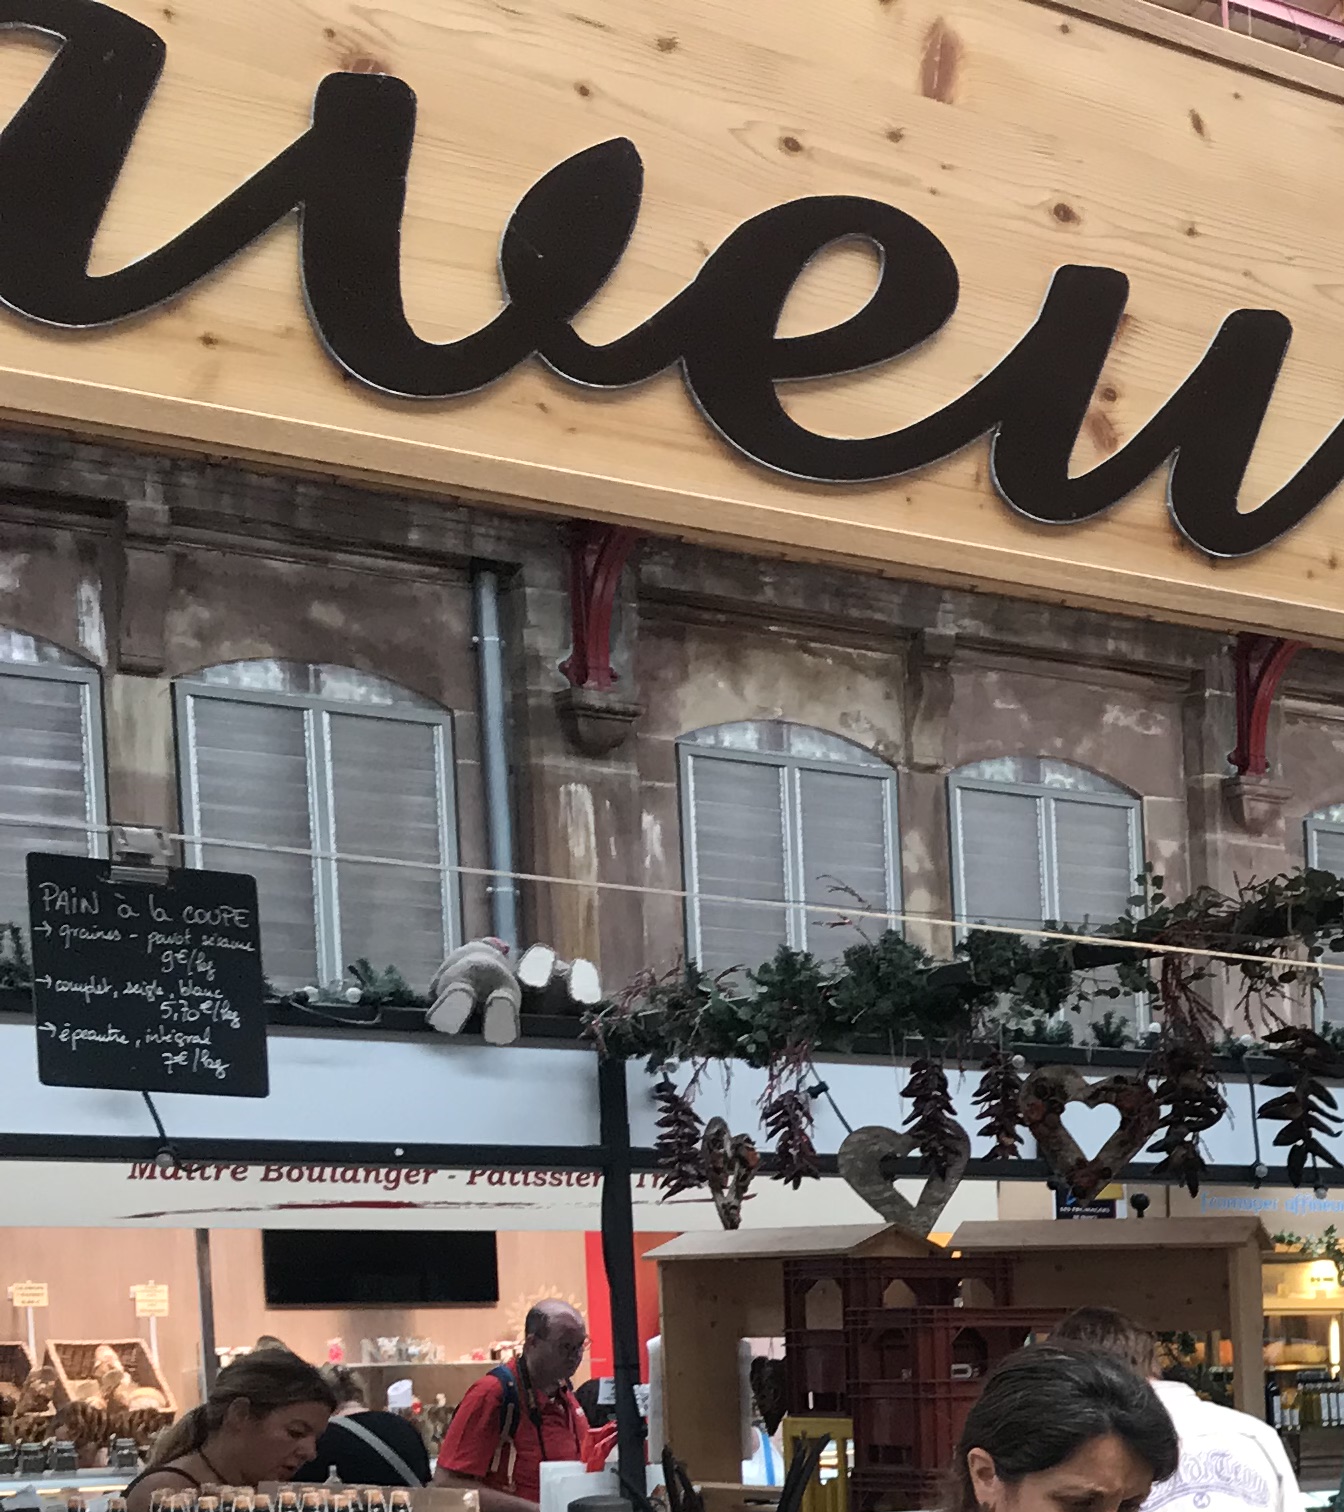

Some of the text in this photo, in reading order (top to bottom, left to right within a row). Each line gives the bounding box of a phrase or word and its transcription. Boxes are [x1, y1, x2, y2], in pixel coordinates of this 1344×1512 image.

[114, 892, 140, 918] à
[149, 893, 174, 922] la
[182, 905, 249, 928] COUPE
